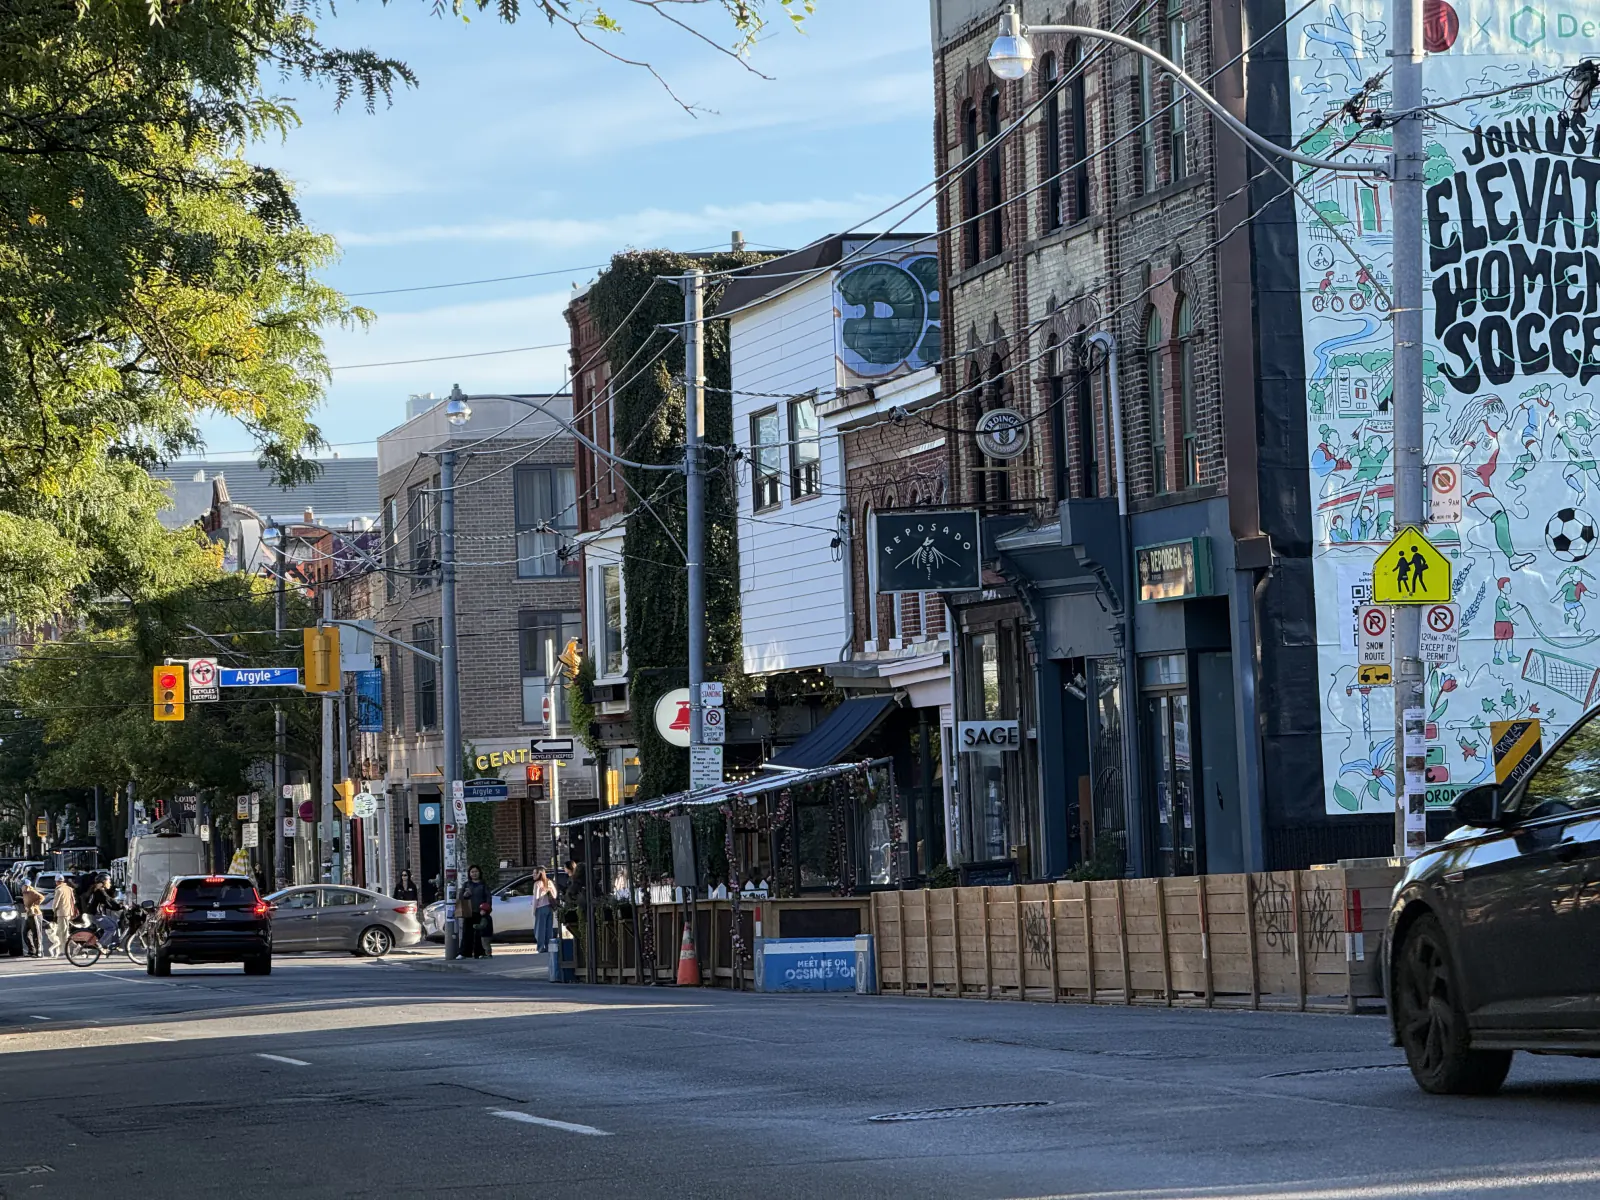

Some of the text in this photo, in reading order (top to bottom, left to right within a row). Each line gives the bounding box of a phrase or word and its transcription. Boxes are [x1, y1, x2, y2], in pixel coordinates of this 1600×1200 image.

[1462, 116, 1543, 165] JOIN
[1544, 113, 1587, 154] US
[1428, 500, 1440, 508] 7AM
[884, 523, 971, 555] REPOSADO
[1150, 547, 1183, 573] REPODEGA
[1366, 642, 1384, 650] SNOW
[1420, 643, 1444, 652] EXCEPT
[1364, 652, 1385, 660] ROUTE
[1426, 652, 1448, 660] PERMIT
[236, 670, 270, 684] Argyle
[964, 727, 1018, 746] SAGE
[472, 788, 492, 796] Argyle
